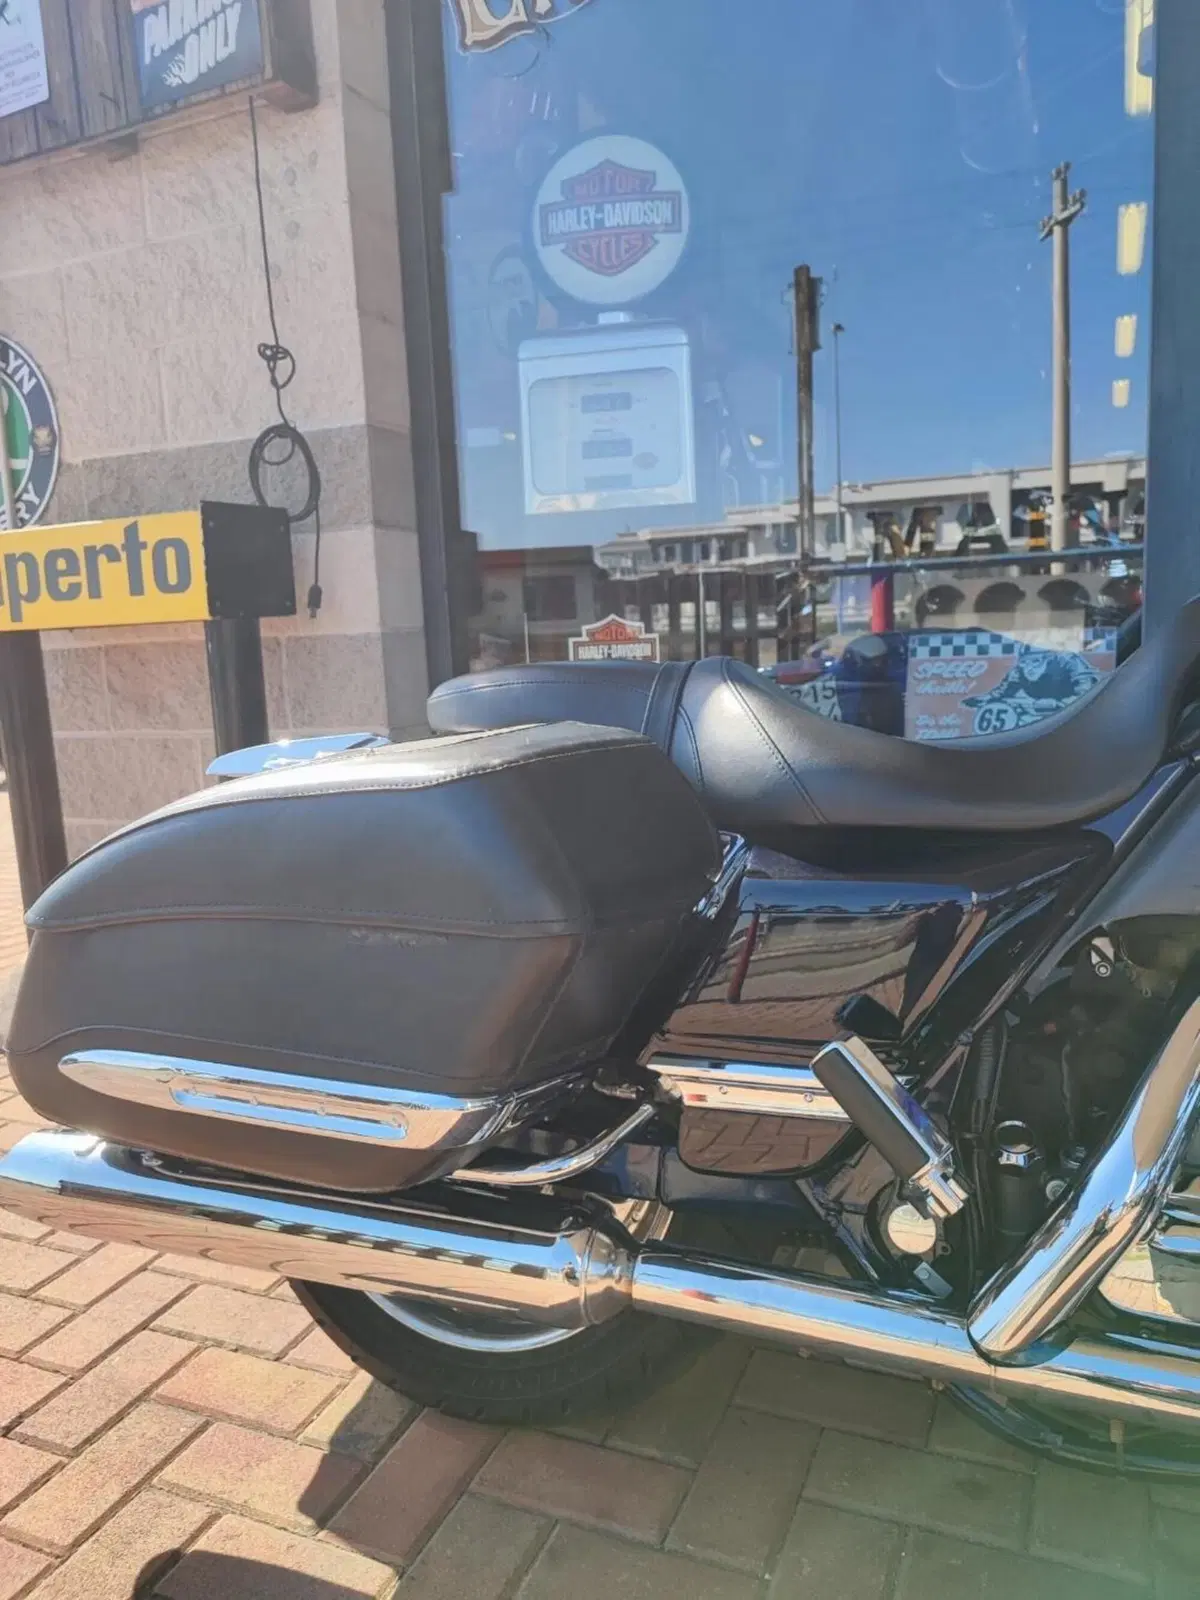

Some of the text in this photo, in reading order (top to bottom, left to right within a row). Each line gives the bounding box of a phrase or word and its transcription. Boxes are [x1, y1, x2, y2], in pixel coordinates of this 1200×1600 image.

[547, 200, 673, 236] HARLEY-DAVIDSON
[577, 231, 644, 267] CYCLES
[0, 521, 193, 623] perto
[913, 660, 988, 679] SPEED
[977, 708, 1009, 732] 65
